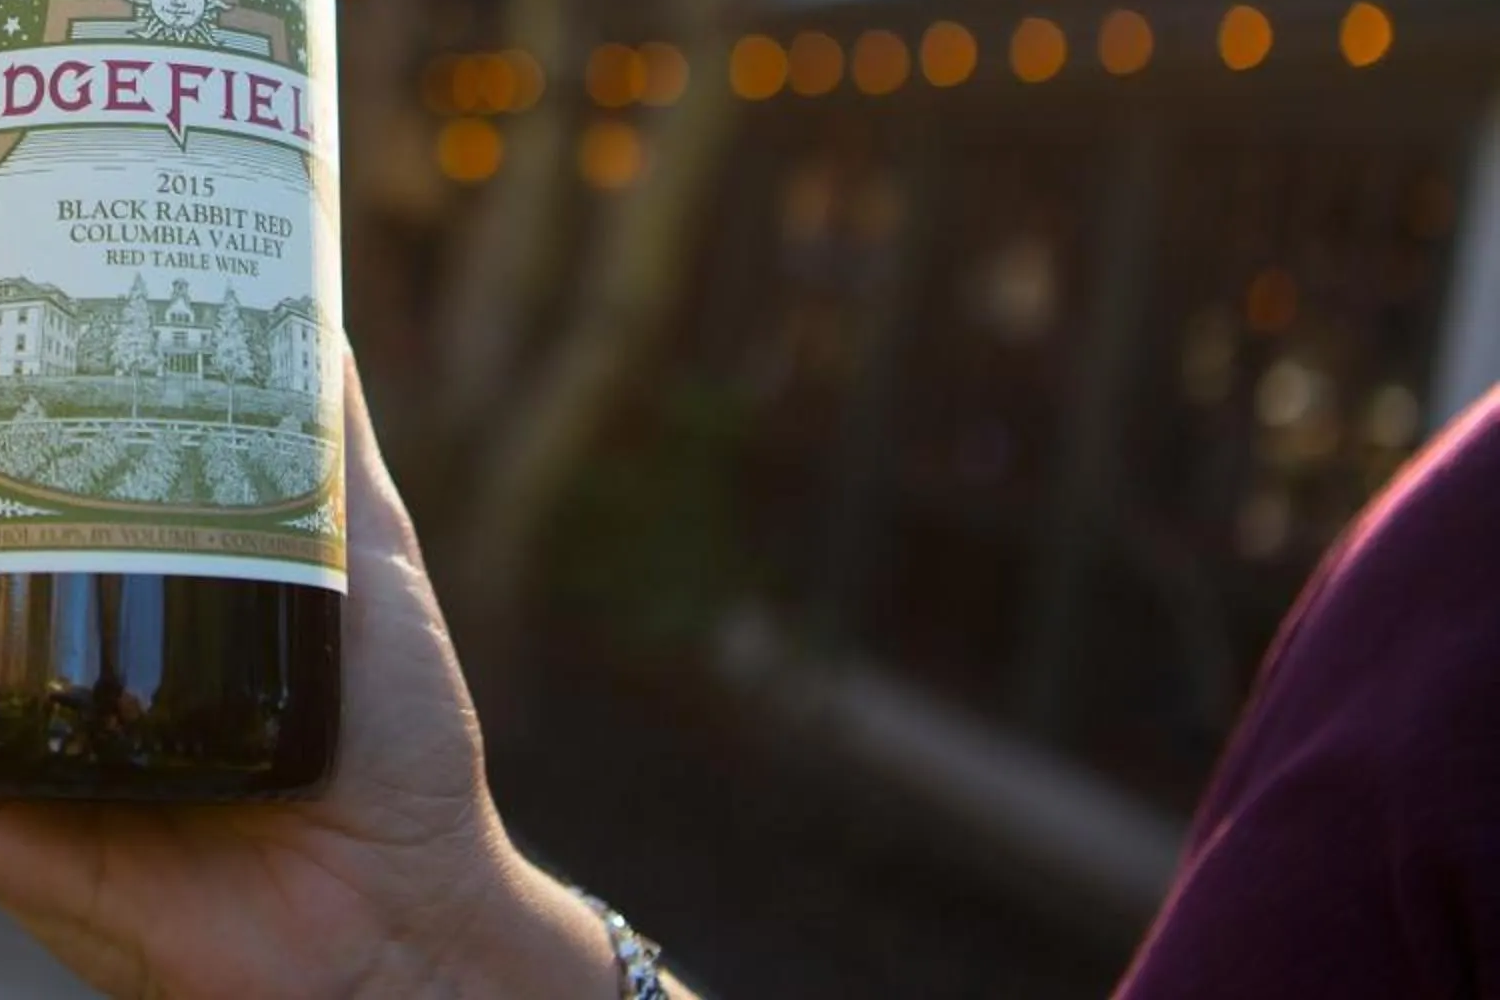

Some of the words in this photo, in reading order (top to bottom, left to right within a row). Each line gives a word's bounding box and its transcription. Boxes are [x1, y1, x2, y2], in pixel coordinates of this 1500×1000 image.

[156, 173, 215, 198] 2015
[57, 199, 148, 222] BLACK
[156, 202, 248, 229] RABBIT
[254, 212, 293, 239] RED
[69, 223, 201, 248] COLUMBIA
[209, 230, 285, 259] VALLEY
[106, 249, 145, 267] RED
[152, 251, 211, 271] TABLE
[215, 255, 261, 278] WINE
[119, 528, 197, 547] VOLUME
